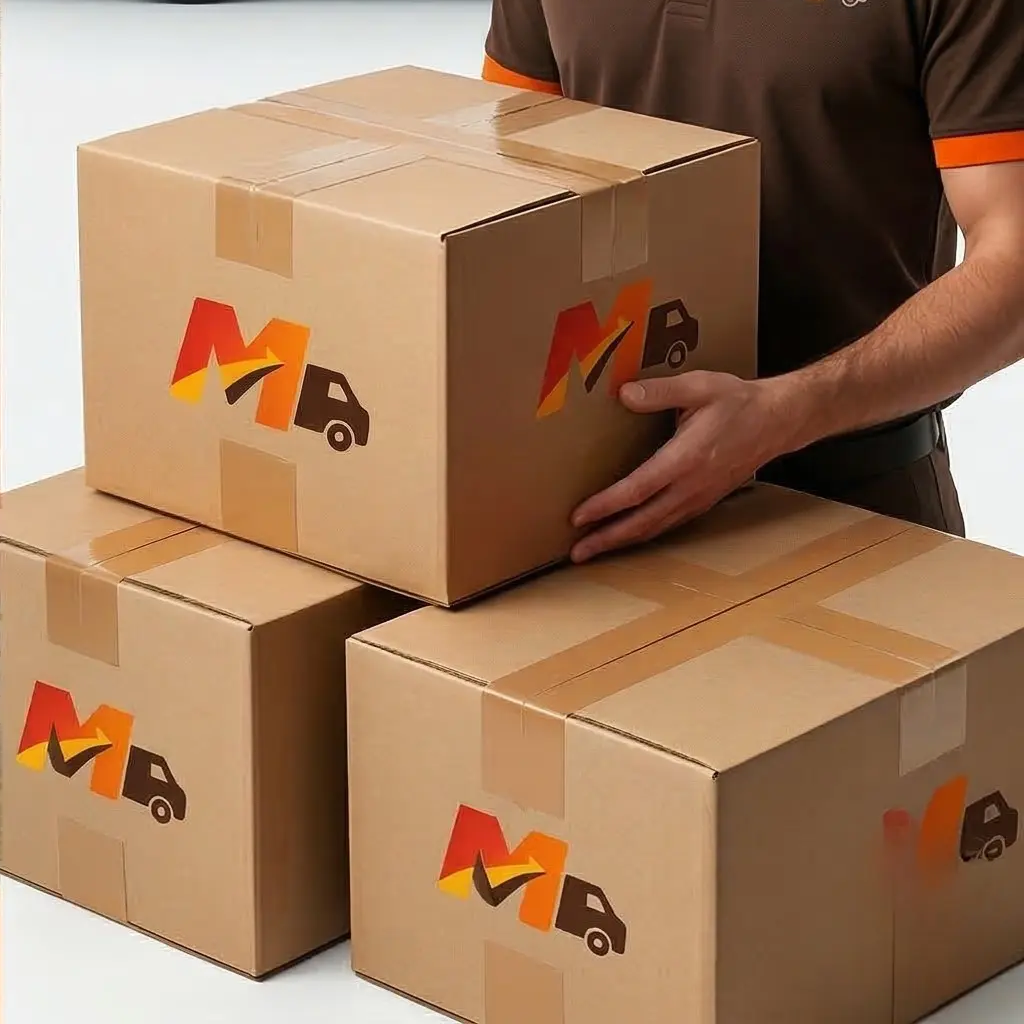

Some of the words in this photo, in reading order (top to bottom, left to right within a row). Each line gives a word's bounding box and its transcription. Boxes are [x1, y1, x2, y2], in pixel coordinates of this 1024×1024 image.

[169, 297, 310, 432] M
[15, 680, 135, 801] M
[436, 803, 568, 934] M
